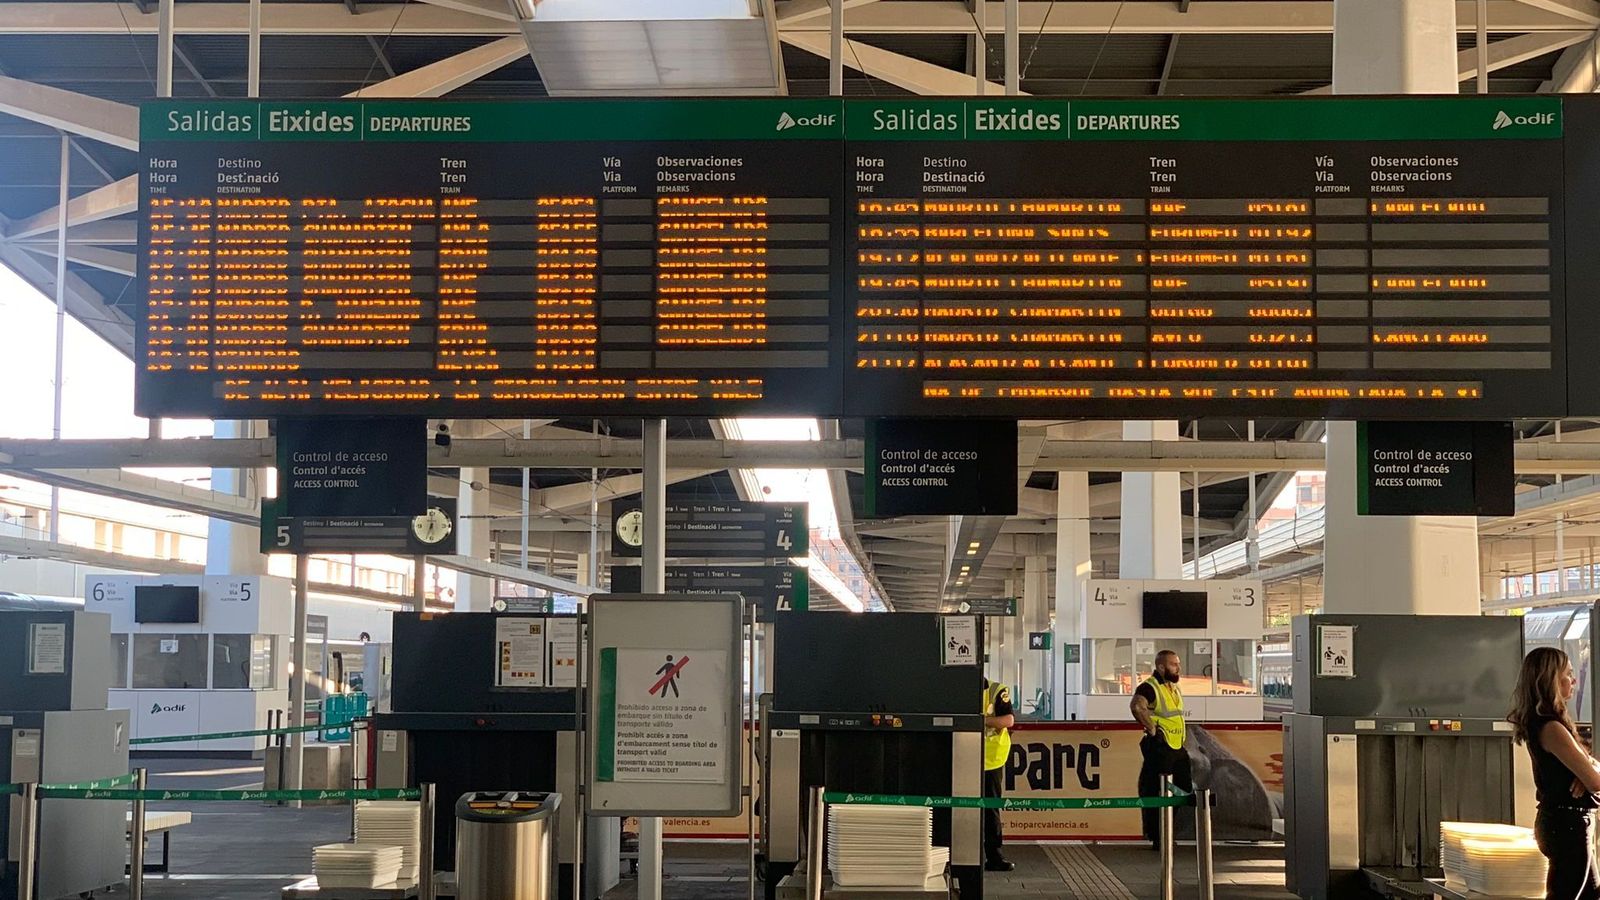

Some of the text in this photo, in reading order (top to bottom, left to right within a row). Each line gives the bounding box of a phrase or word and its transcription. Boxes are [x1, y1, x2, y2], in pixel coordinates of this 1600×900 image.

[168, 110, 471, 132] Salidas Eixides DEPARTURES
[797, 114, 836, 126] adif
[873, 108, 1180, 131] Salidas Eixides DEPARTURES
[1515, 112, 1555, 125] adif
[150, 158, 177, 168] Hora
[218, 158, 261, 169] Destino
[440, 158, 466, 168] Tren
[603, 156, 621, 168] Vía
[657, 156, 743, 167] Observaciones
[856, 157, 884, 167] Hora
[924, 157, 967, 168] Destino
[1150, 157, 1176, 168] Tren
[1316, 156, 1334, 167] Vía
[1370, 156, 1458, 166] Observaciones
[150, 173, 177, 183] Hora
[218, 172, 279, 184] Destinació
[440, 173, 466, 183] Tren
[603, 172, 621, 182] Via
[657, 172, 736, 182] Observacions
[856, 172, 884, 182] Hora
[923, 171, 985, 182] Destinació
[1150, 172, 1176, 182] Tren
[1316, 171, 1334, 182] Via
[1370, 170, 1452, 182] Observacions
[293, 452, 388, 462] Control de acceso
[882, 450, 978, 460] Control de acceso
[1374, 450, 1472, 460] Control de acceso
[293, 466, 366, 476] Control d'accés
[882, 464, 955, 473] Control d'accés
[1374, 464, 1450, 473] Control d'accés
[294, 480, 359, 488] ACCESS CONTROL
[882, 478, 948, 486] ACCESS CONTROL
[1376, 478, 1442, 486] ACCESS CONTROL
[278, 526, 290, 547] 5
[776, 530, 792, 550] 4
[92, 582, 104, 601] 6
[240, 582, 251, 601] 5
[1094, 588, 1107, 605] 4
[1244, 588, 1255, 606] 3
[163, 704, 186, 712] adif
[1010, 821, 1089, 830] bioparcvalencia.es
